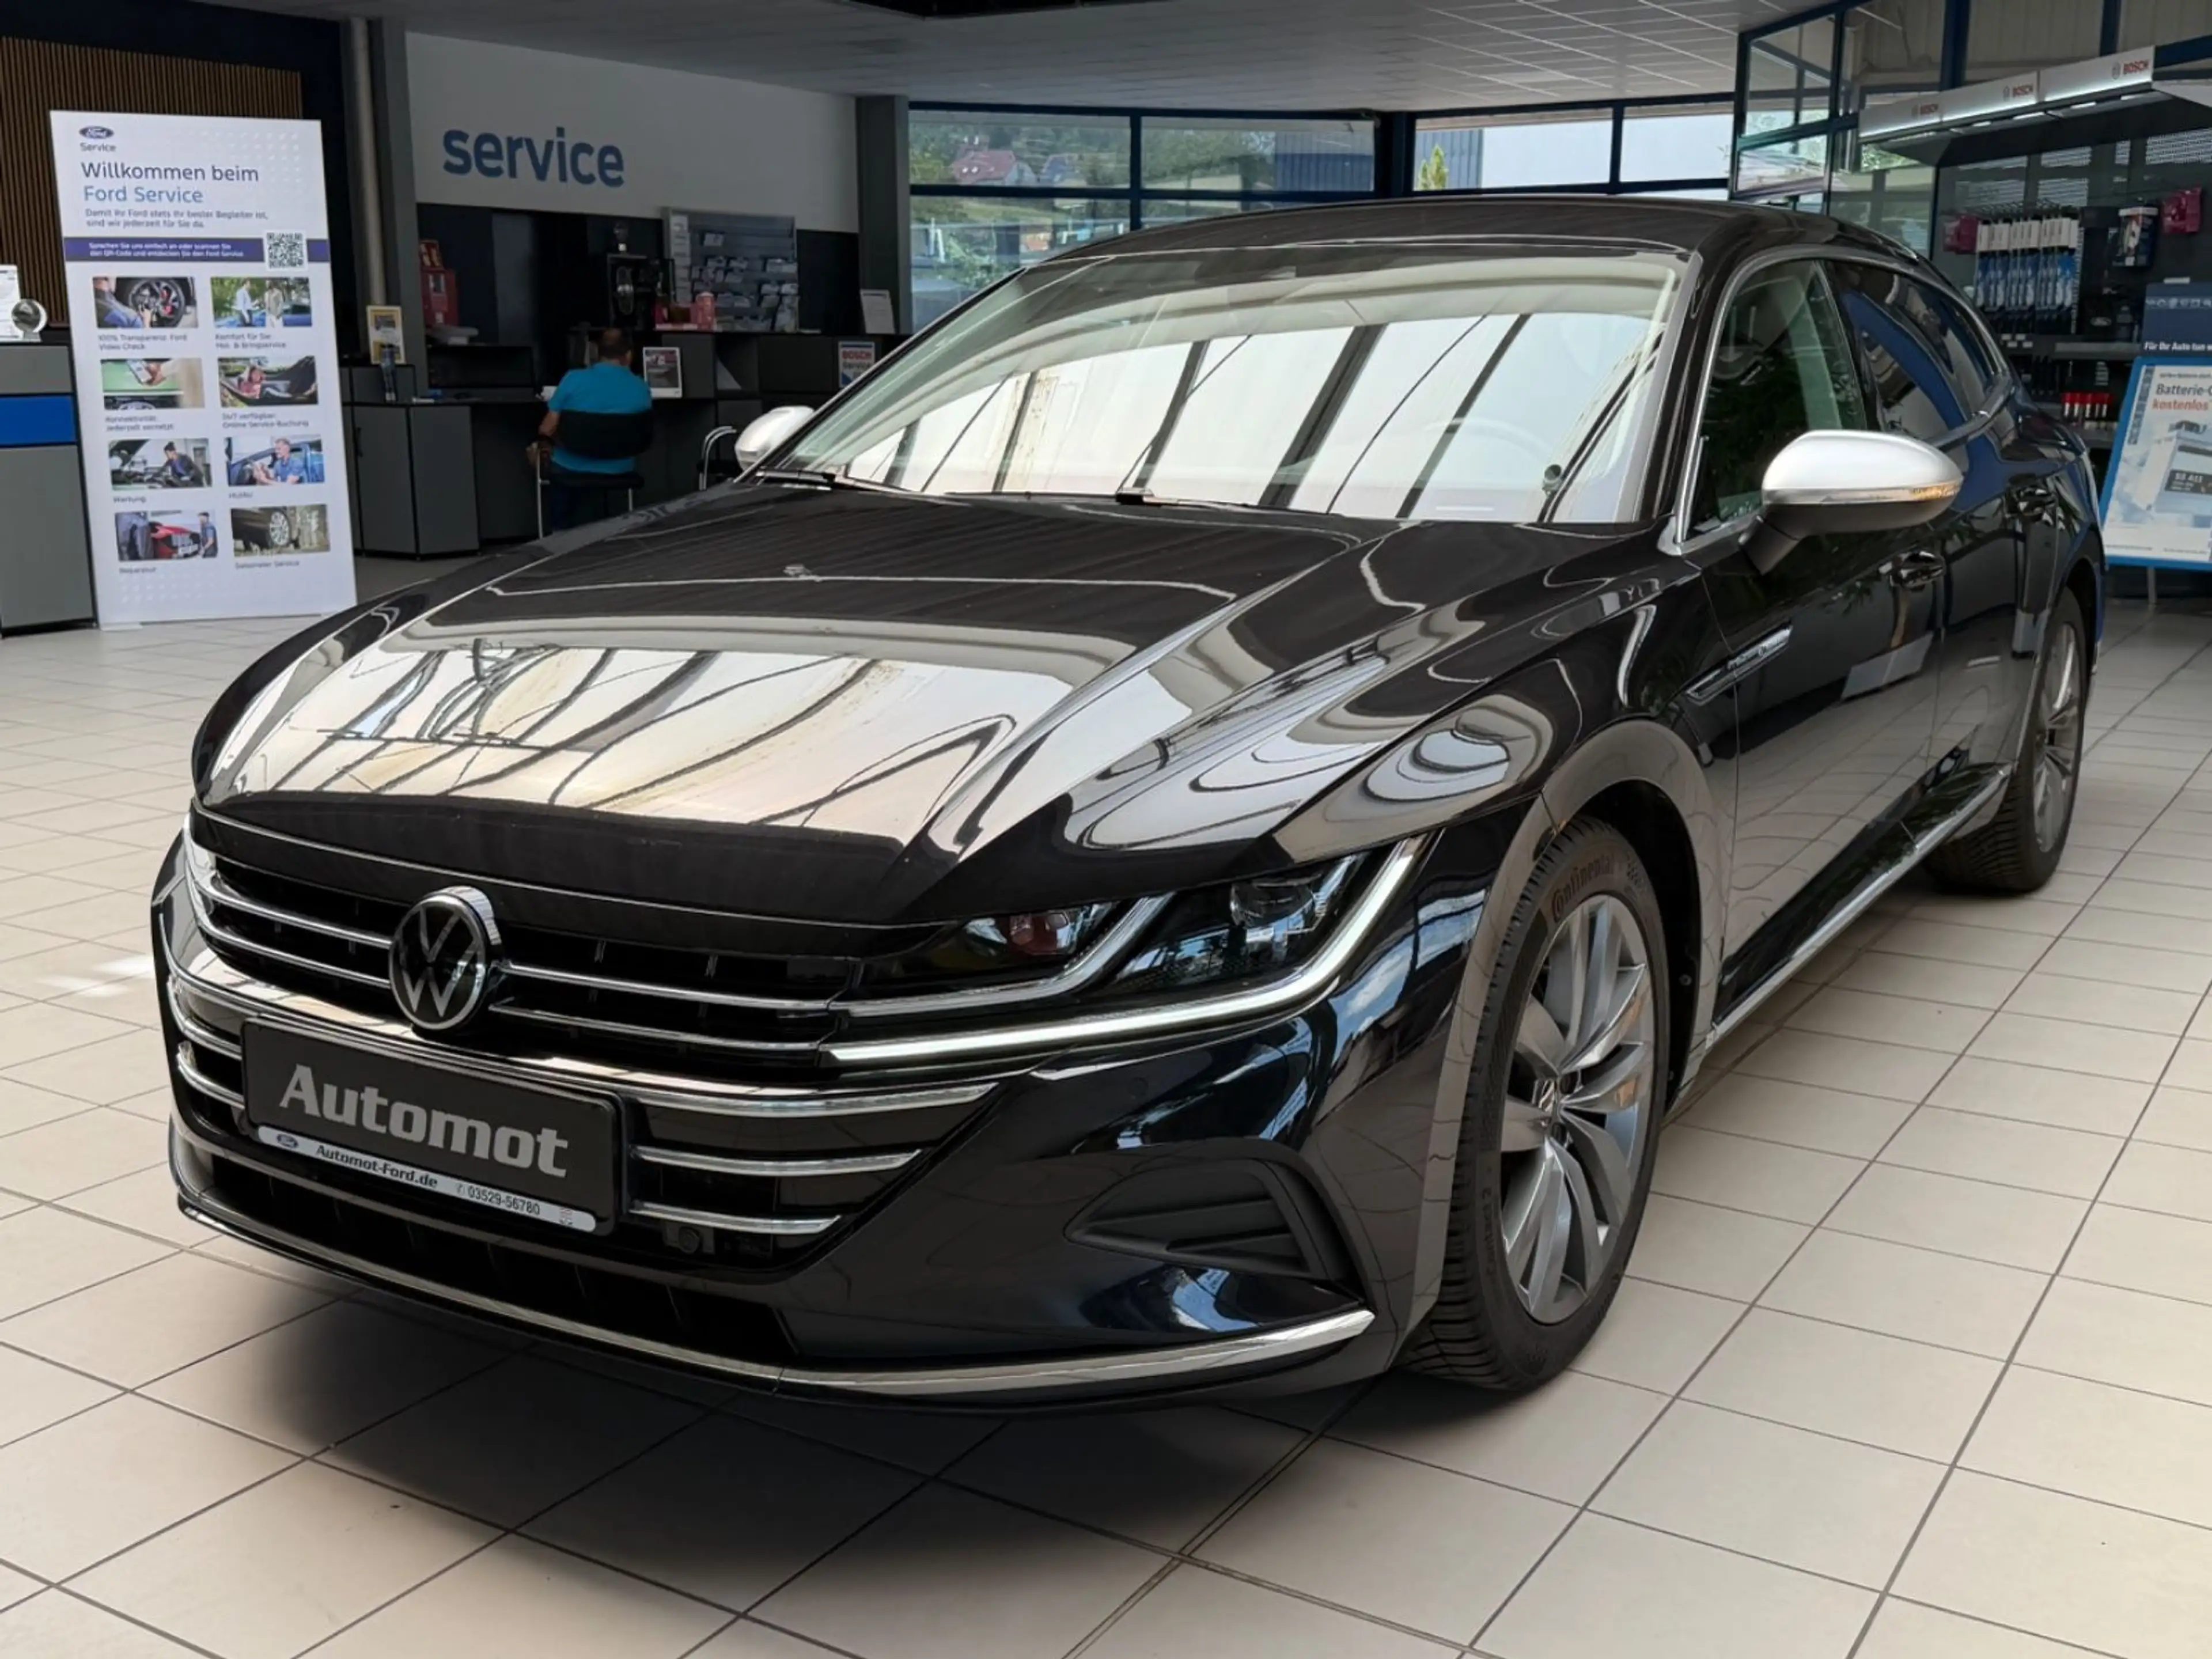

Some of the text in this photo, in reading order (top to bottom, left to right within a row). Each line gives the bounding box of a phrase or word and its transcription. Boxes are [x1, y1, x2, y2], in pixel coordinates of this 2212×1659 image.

[2124, 60, 2149, 75] BOSCH
[79, 142, 116, 152] Service
[442, 126, 625, 188] service
[80, 161, 259, 182] Willkommen beim
[84, 185, 203, 203] Ford Service
[85, 209, 112, 217] Damit
[127, 209, 148, 217] Ford
[86, 219, 105, 227] sind
[2172, 342, 2191, 351] Auto
[842, 350, 872, 360] BOSCH
[2152, 399, 2209, 411] kostenlos
[279, 1063, 569, 1178] Automot
[316, 1145, 438, 1189] Automot-Ford.de
[467, 1185, 541, 1216] 03529-56780
